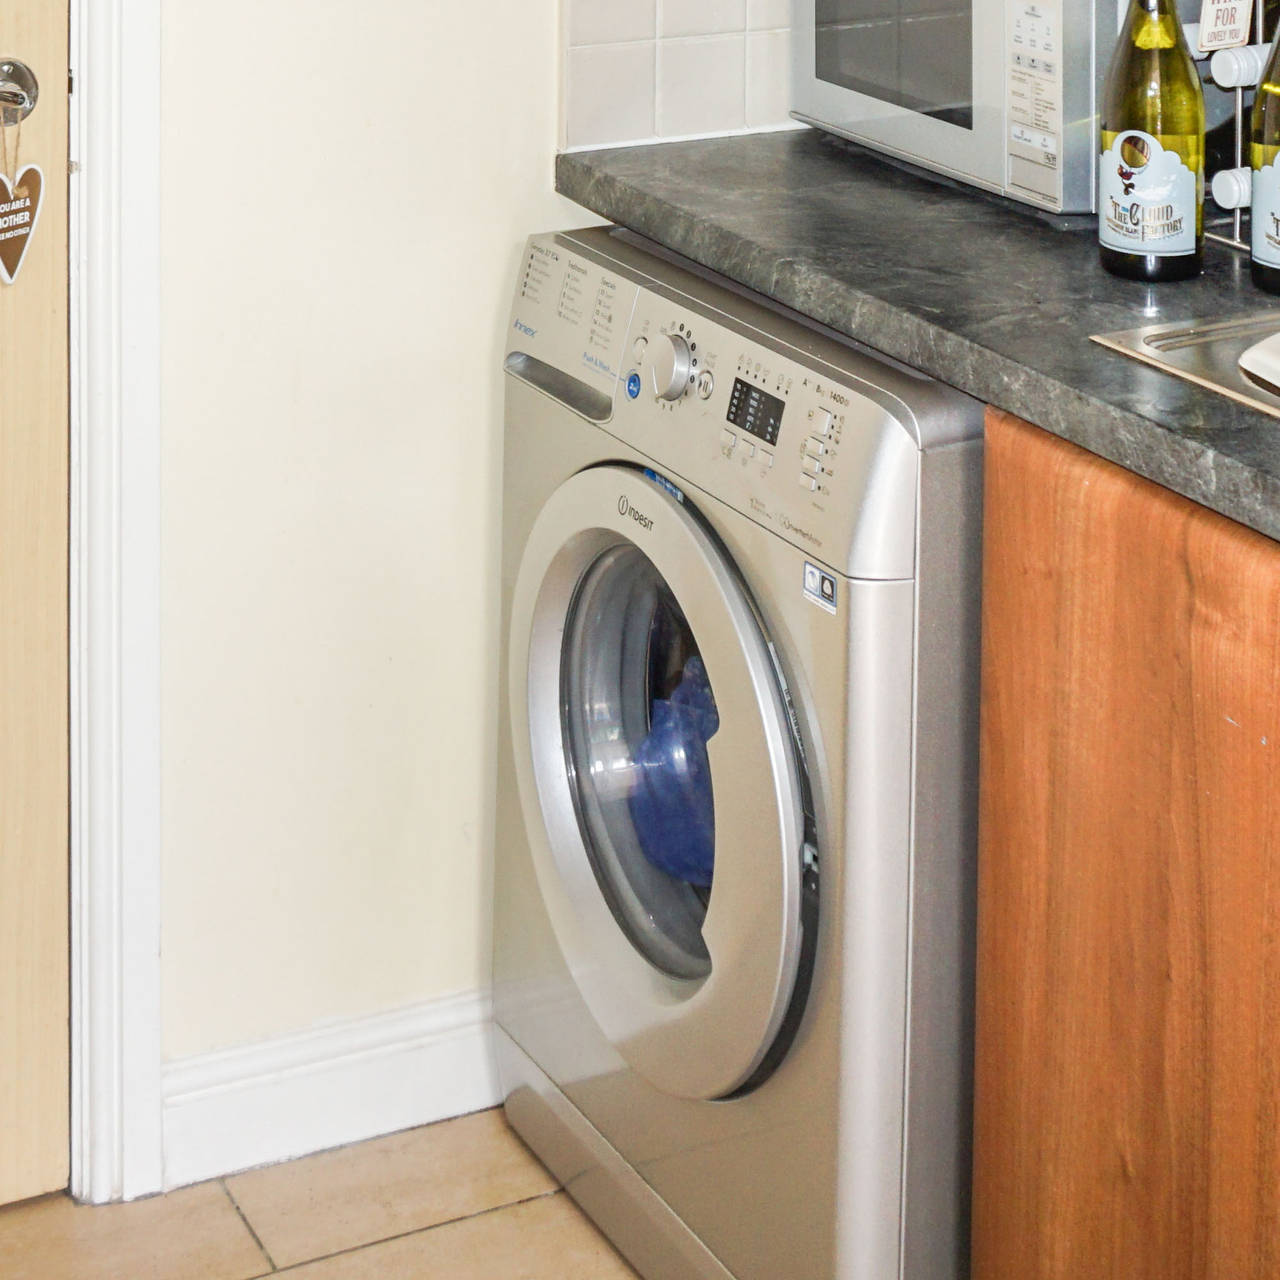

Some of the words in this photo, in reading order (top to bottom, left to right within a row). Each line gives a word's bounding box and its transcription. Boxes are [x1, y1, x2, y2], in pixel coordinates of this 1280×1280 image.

[1214, 6, 1237, 27] FOR
[1229, 28, 1241, 40] YOU
[10, 199, 25, 211] ARE
[25, 198, 30, 206] A
[1111, 200, 1128, 224] THE
